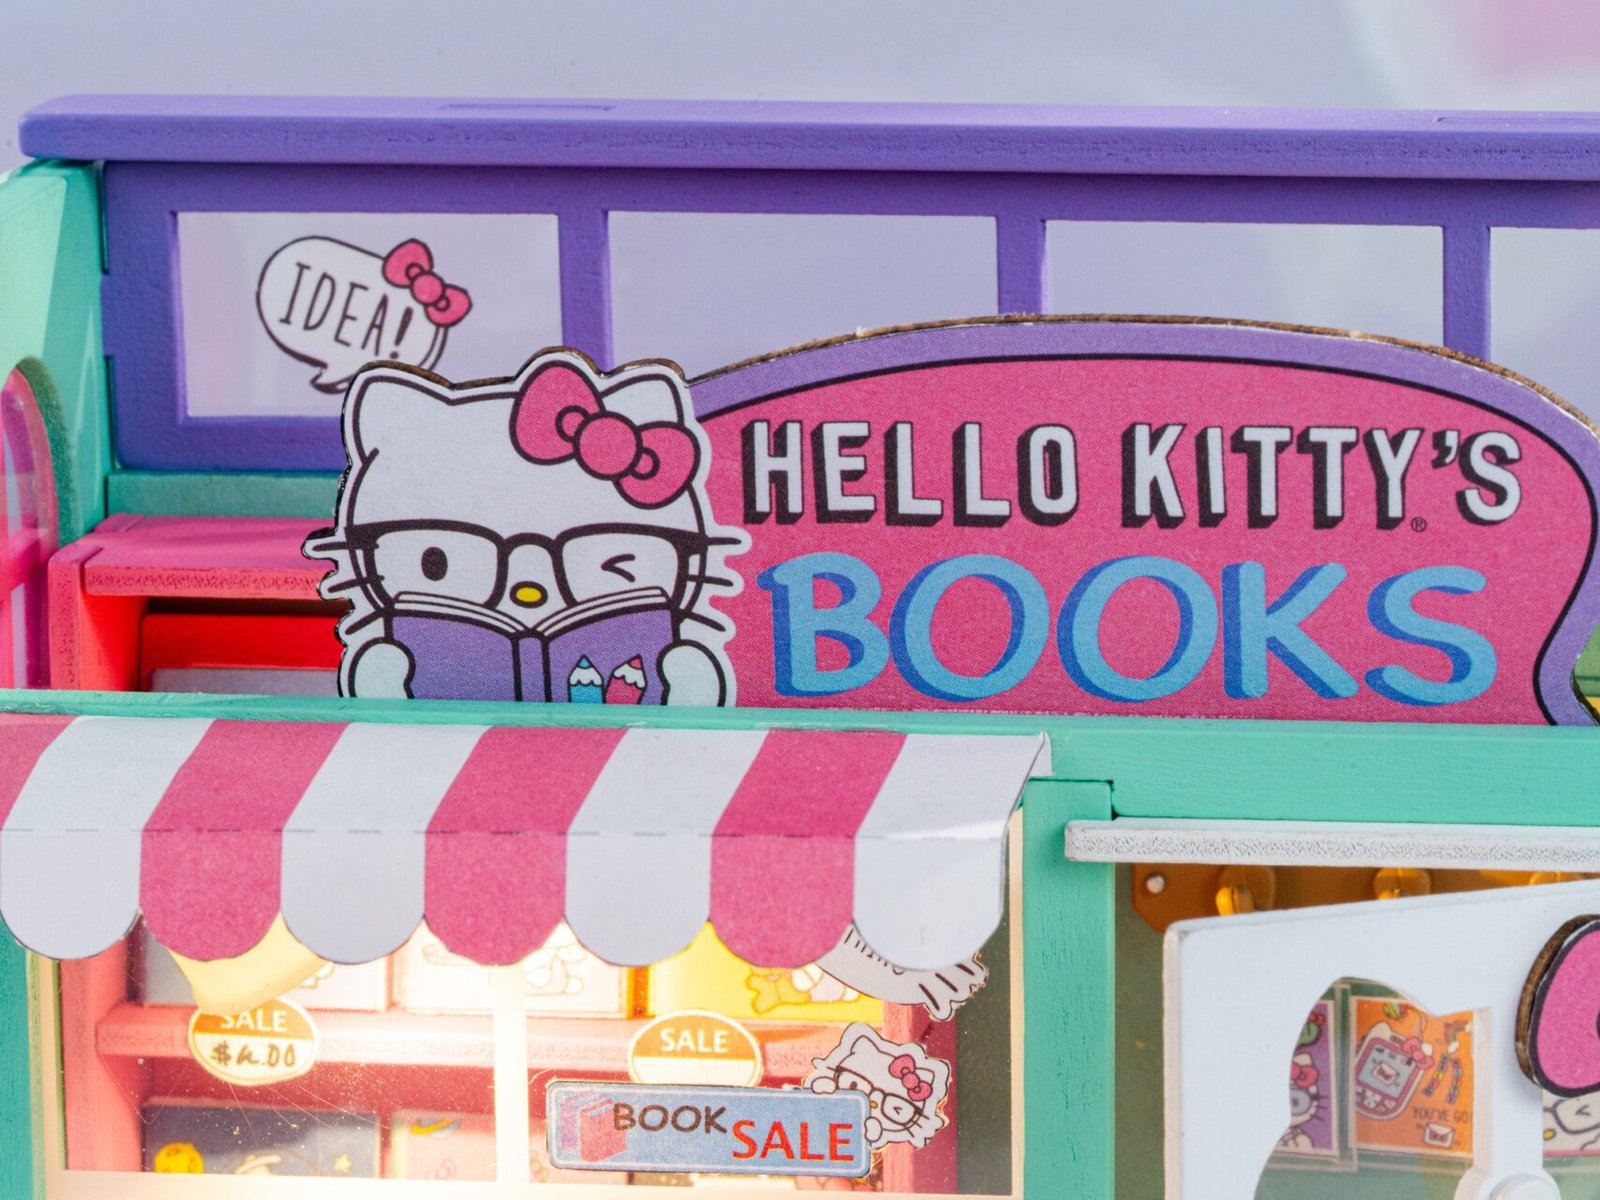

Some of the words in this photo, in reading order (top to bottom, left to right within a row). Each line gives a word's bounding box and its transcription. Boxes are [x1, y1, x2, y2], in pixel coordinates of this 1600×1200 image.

[278, 261, 414, 360] IDEA!
[740, 418, 1080, 527] HELLO
[1121, 422, 1523, 532] KITTY'S
[756, 551, 1498, 707] BOOKS
[219, 1007, 289, 1034] SALE
[659, 1027, 729, 1054] SALE
[612, 1103, 728, 1134] BOOK
[731, 1119, 855, 1163] SALE
